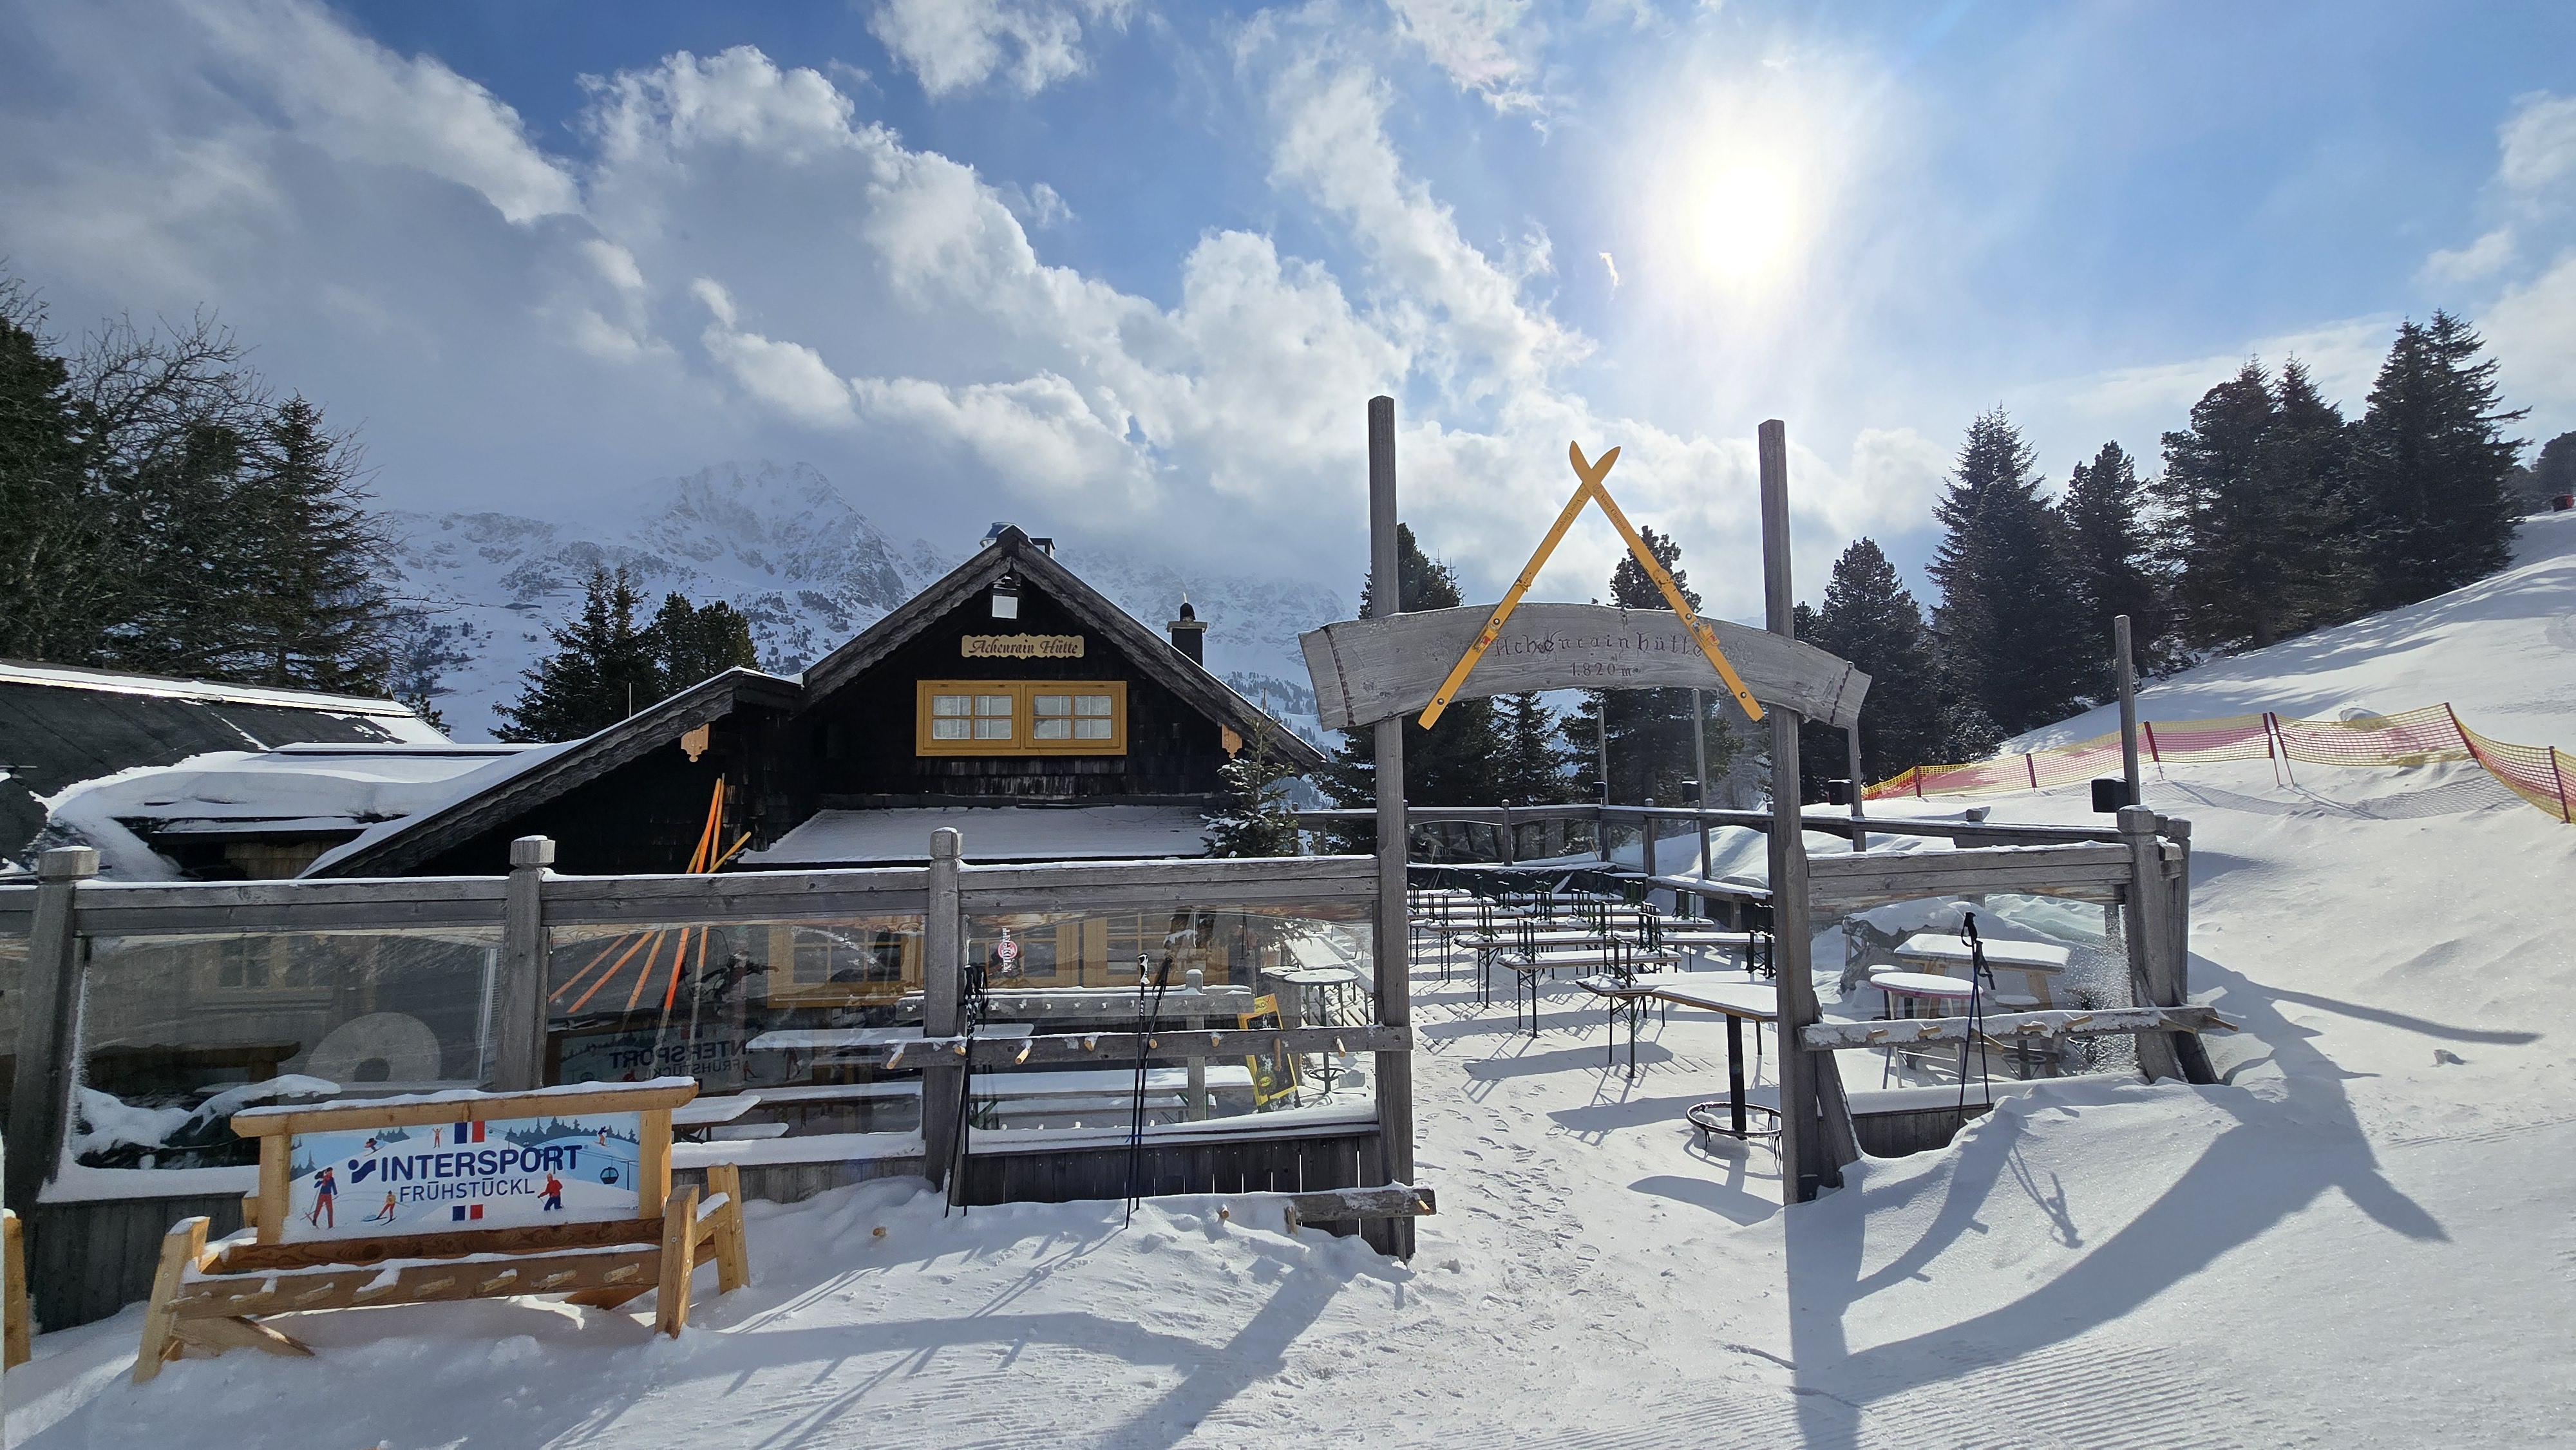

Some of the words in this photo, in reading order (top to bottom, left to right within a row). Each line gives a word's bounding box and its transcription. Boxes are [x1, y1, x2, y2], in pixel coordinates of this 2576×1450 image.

[1570, 498, 1583, 513] Veuve
[1600, 493, 1611, 509] Veuve
[1610, 509, 1627, 531] Clicquot
[1556, 512, 1573, 533] Clicquot
[969, 638, 1034, 654] Achenrain
[1039, 638, 1078, 654] Hütte
[1569, 661, 1616, 677] 1.820
[381, 1144, 583, 1183] INTERSPORT
